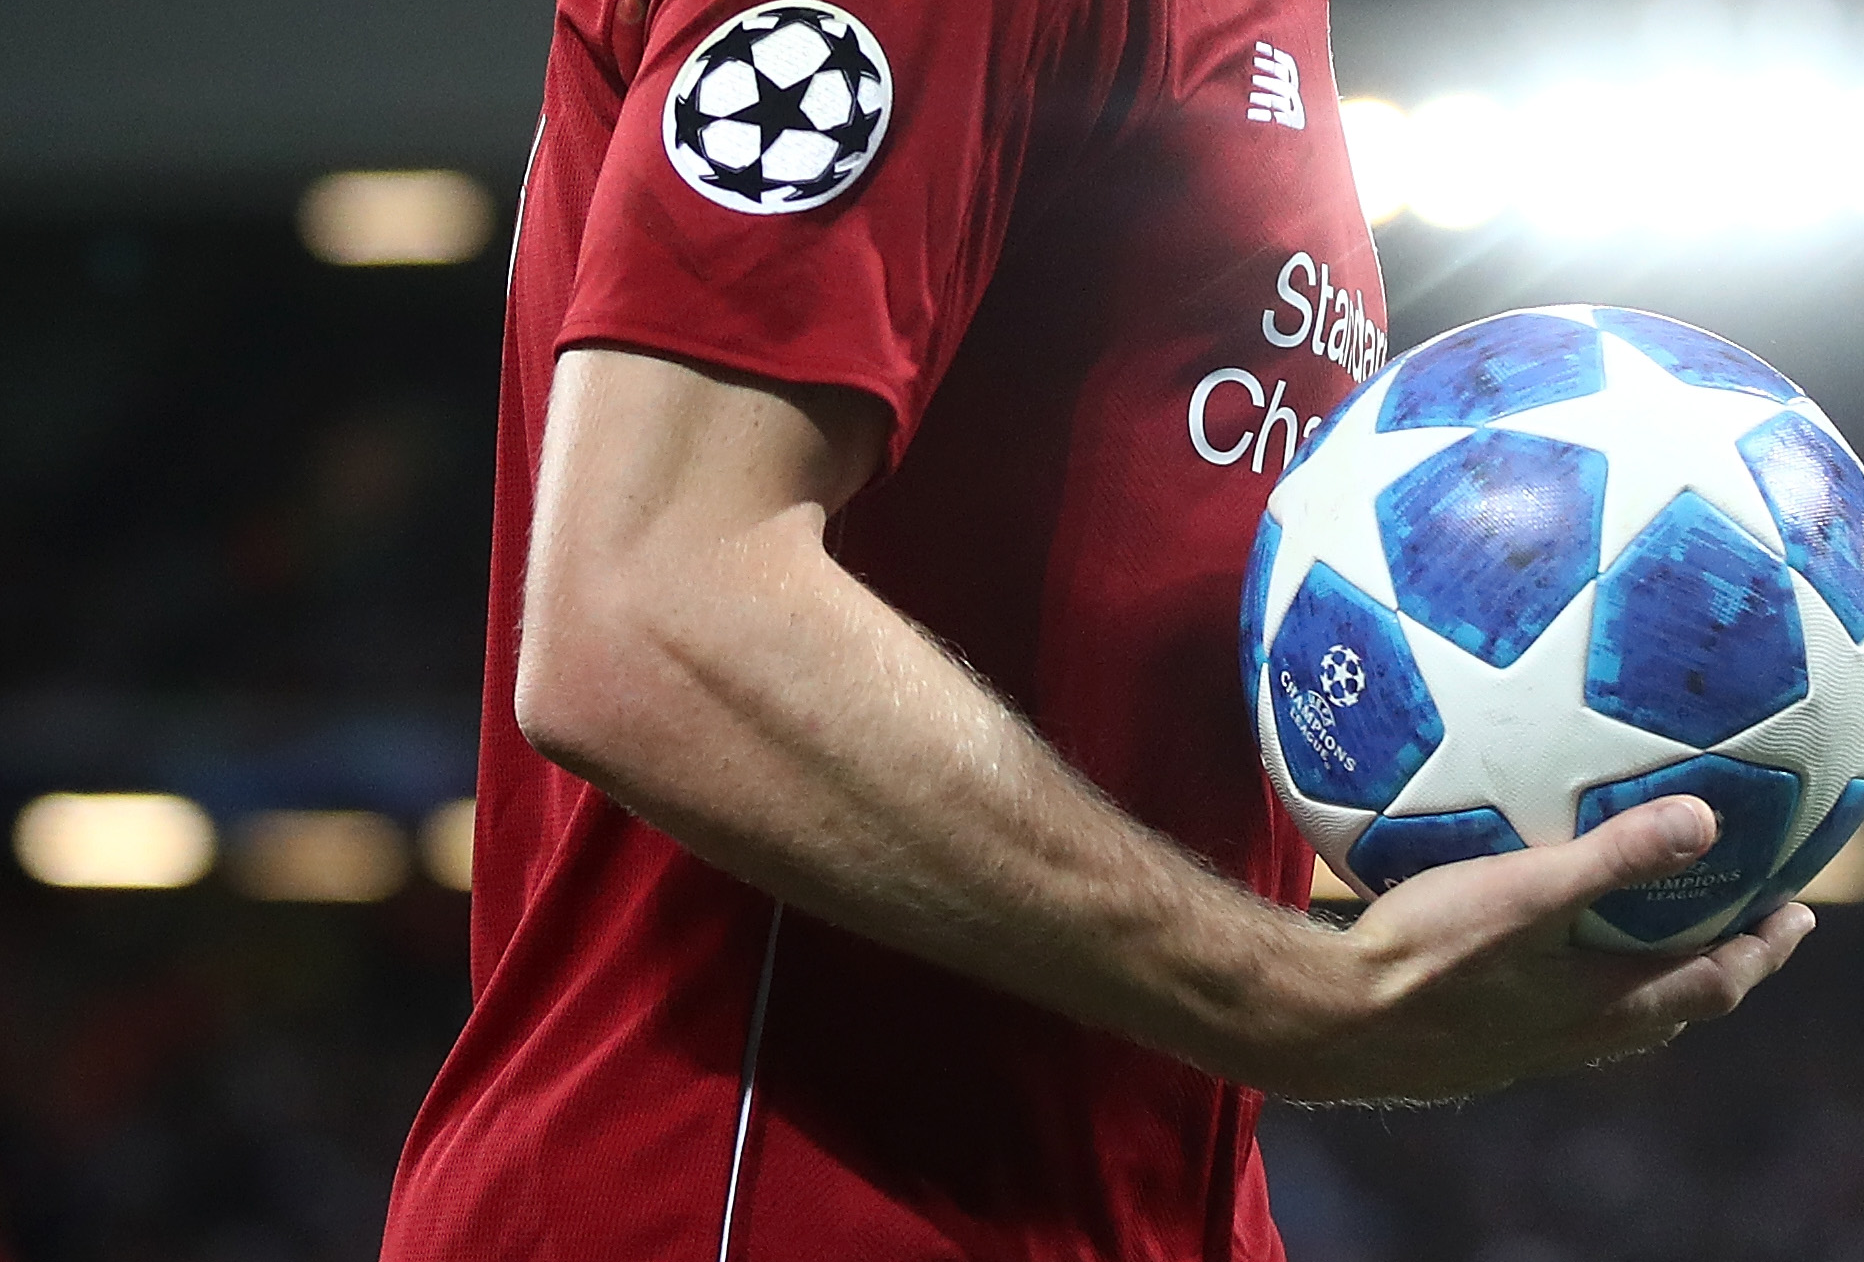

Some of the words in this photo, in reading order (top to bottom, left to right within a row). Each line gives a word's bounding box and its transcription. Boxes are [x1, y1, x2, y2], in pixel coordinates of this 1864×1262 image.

[1262, 251, 1388, 383] Standar
[1281, 671, 1357, 771] CHAMPIONS
[1290, 706, 1329, 761] LEAGUE
[1646, 887, 1707, 901] LEAGUE
